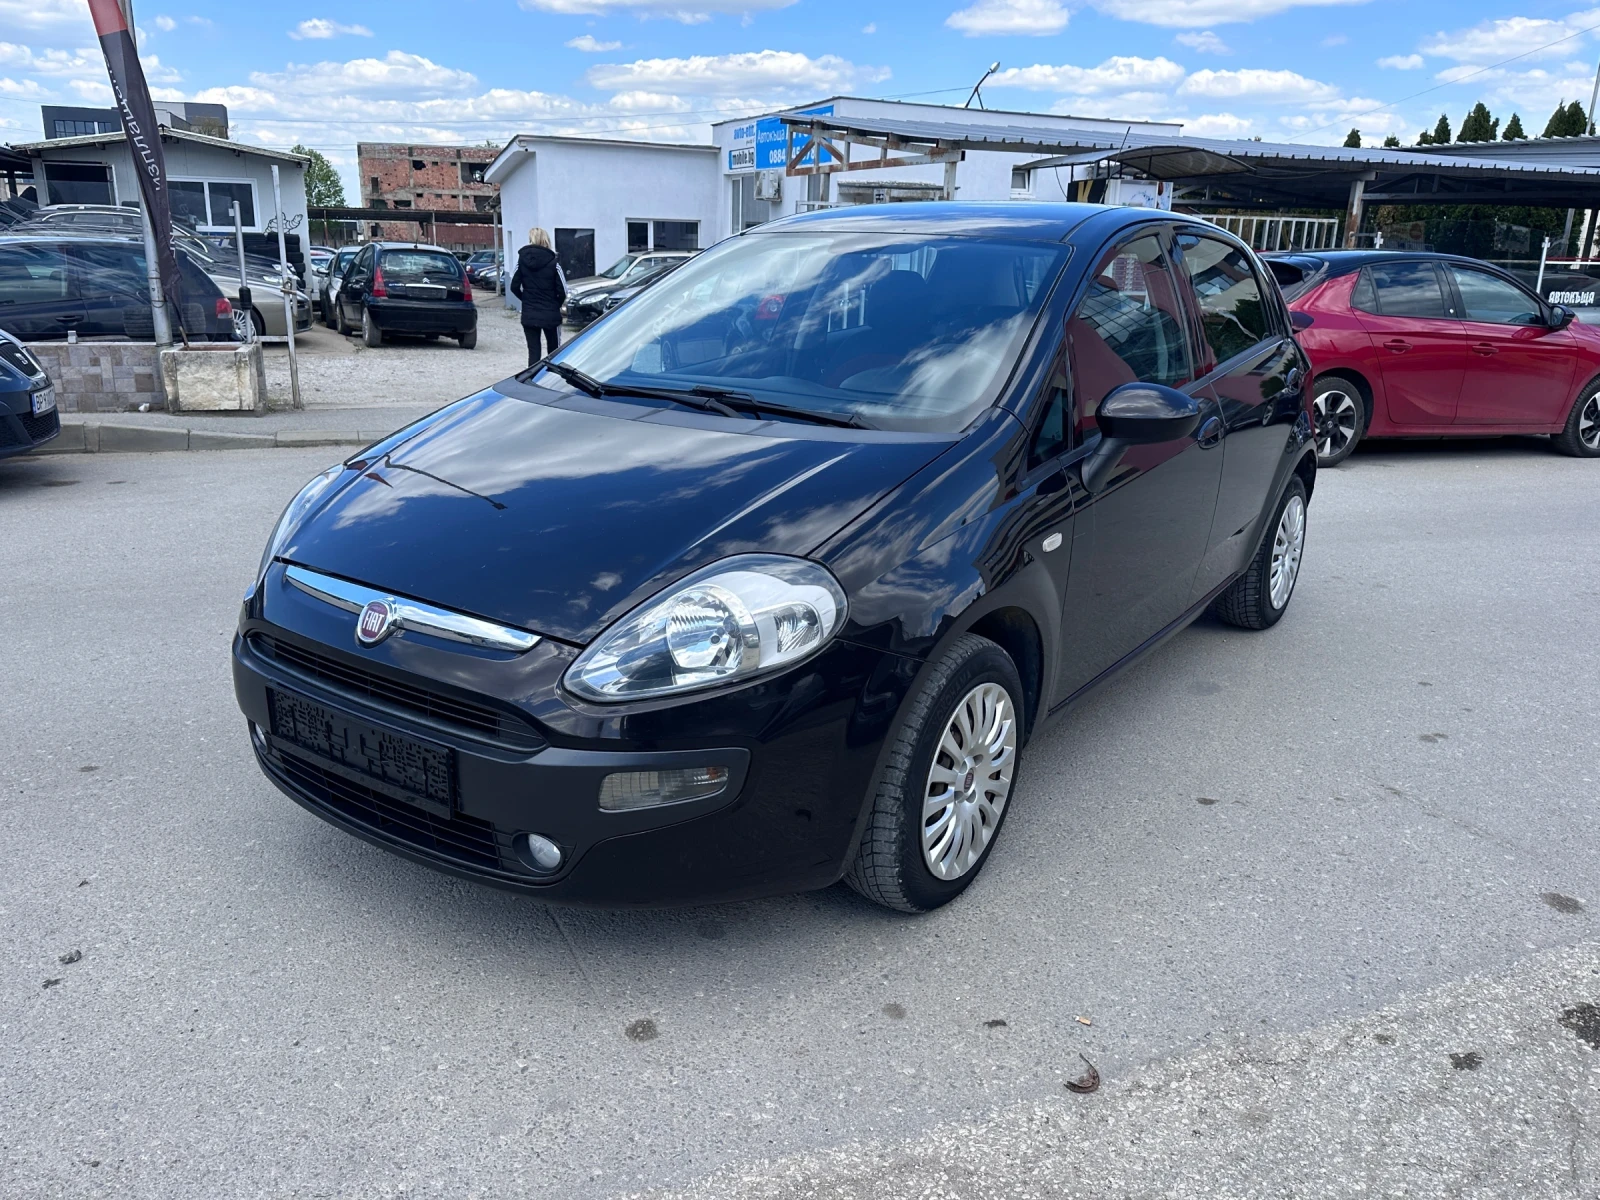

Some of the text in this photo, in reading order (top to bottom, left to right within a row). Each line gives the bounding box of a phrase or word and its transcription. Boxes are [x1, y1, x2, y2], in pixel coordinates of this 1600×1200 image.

[104, 54, 161, 191] изплащ
[757, 128, 785, 144] Автокъща
[732, 150, 754, 165] mobile.bg
[769, 148, 786, 164] 0884
[1548, 291, 1595, 306] АВТОКЪЩА
[362, 610, 385, 633] FIAT
